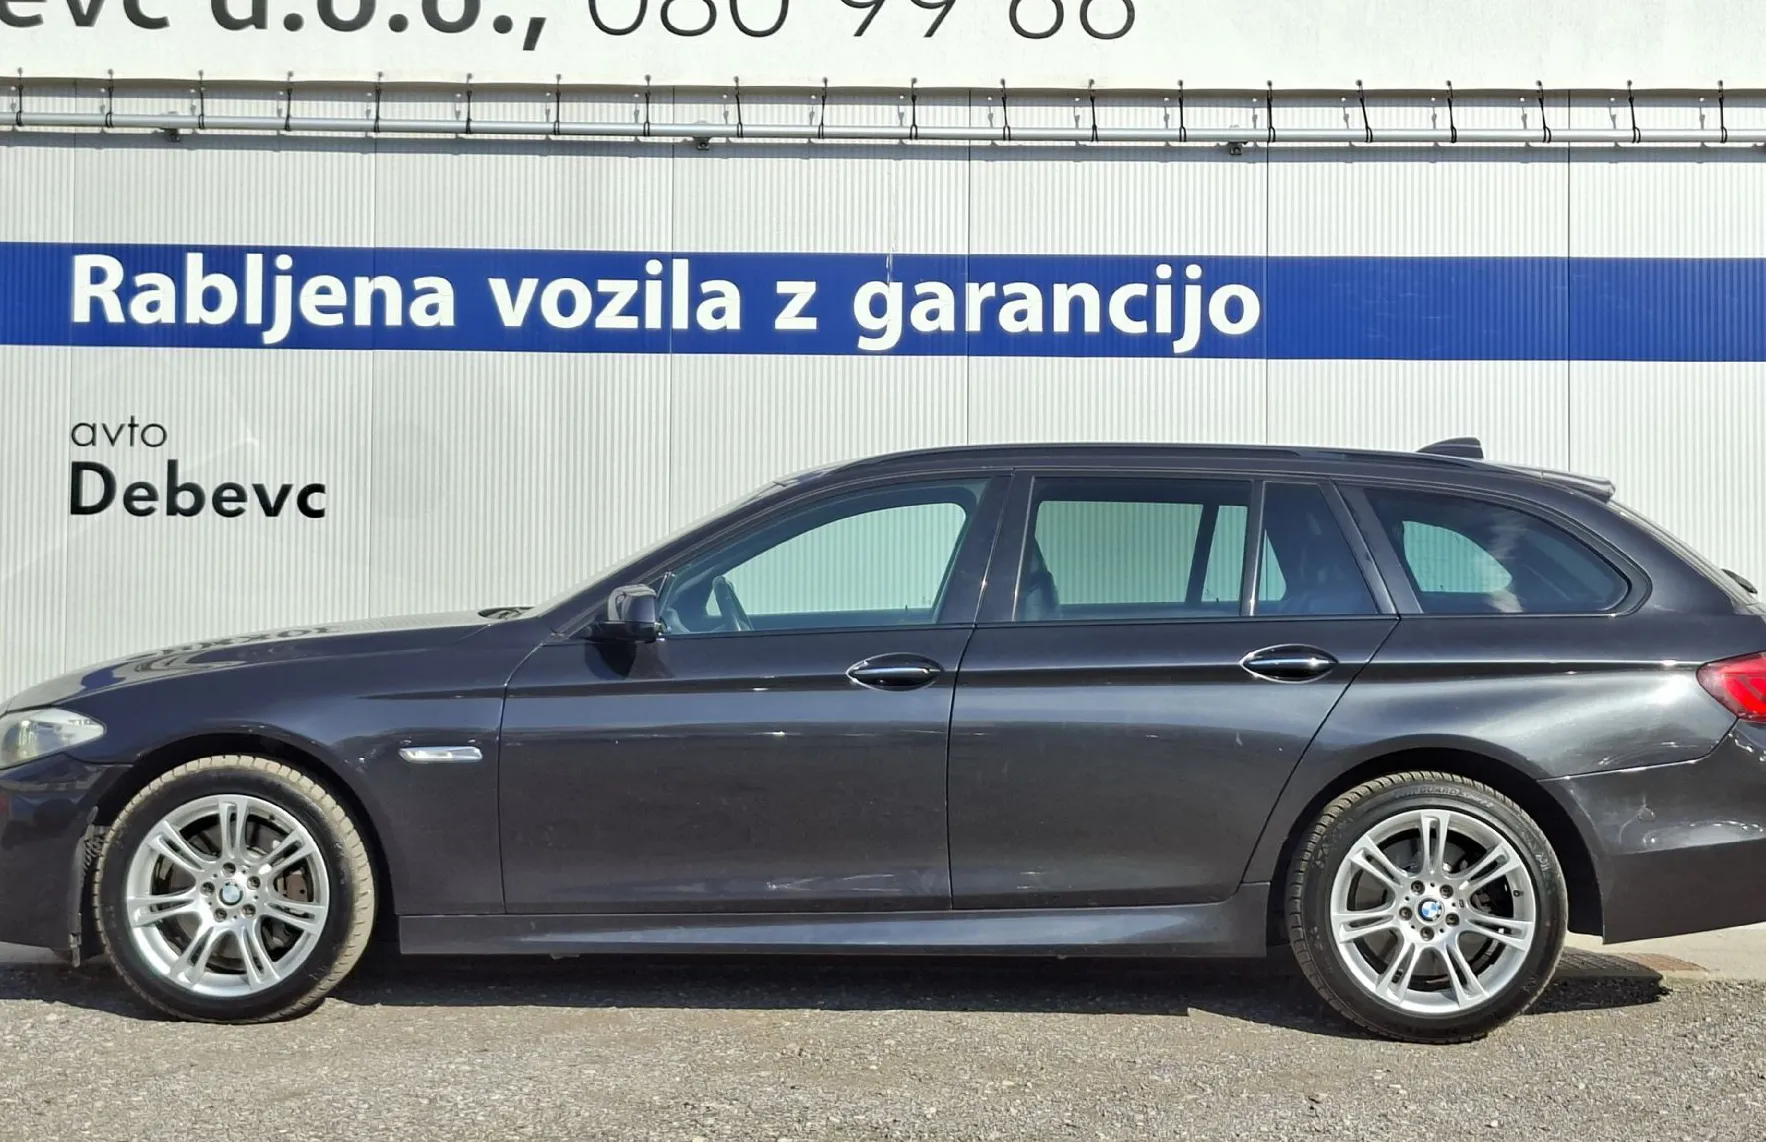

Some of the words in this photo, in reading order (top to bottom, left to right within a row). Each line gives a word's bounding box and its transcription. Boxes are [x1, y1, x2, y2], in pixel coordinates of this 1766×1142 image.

[71, 252, 455, 345] Rabljena
[487, 258, 741, 331] vozila
[774, 280, 818, 331] z
[853, 263, 1261, 354] garancijo
[70, 415, 168, 448] avto
[70, 459, 326, 518] Debevc
